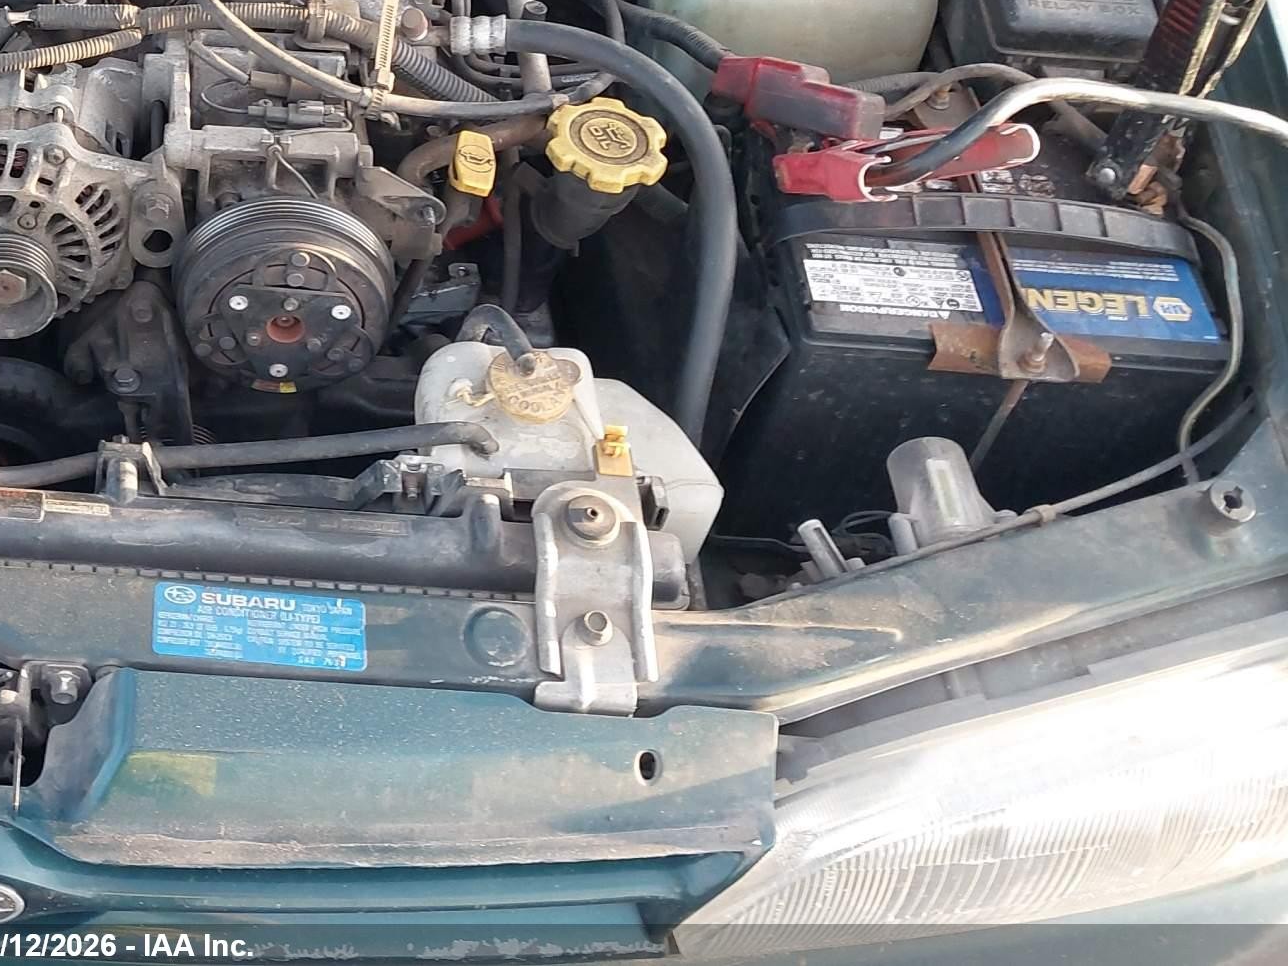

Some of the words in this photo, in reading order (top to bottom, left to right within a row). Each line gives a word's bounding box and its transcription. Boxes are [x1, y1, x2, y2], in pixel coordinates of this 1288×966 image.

[587, 125, 612, 150] OIL
[1021, 288, 1152, 318] LEGEN
[201, 592, 296, 611] SUBARU
